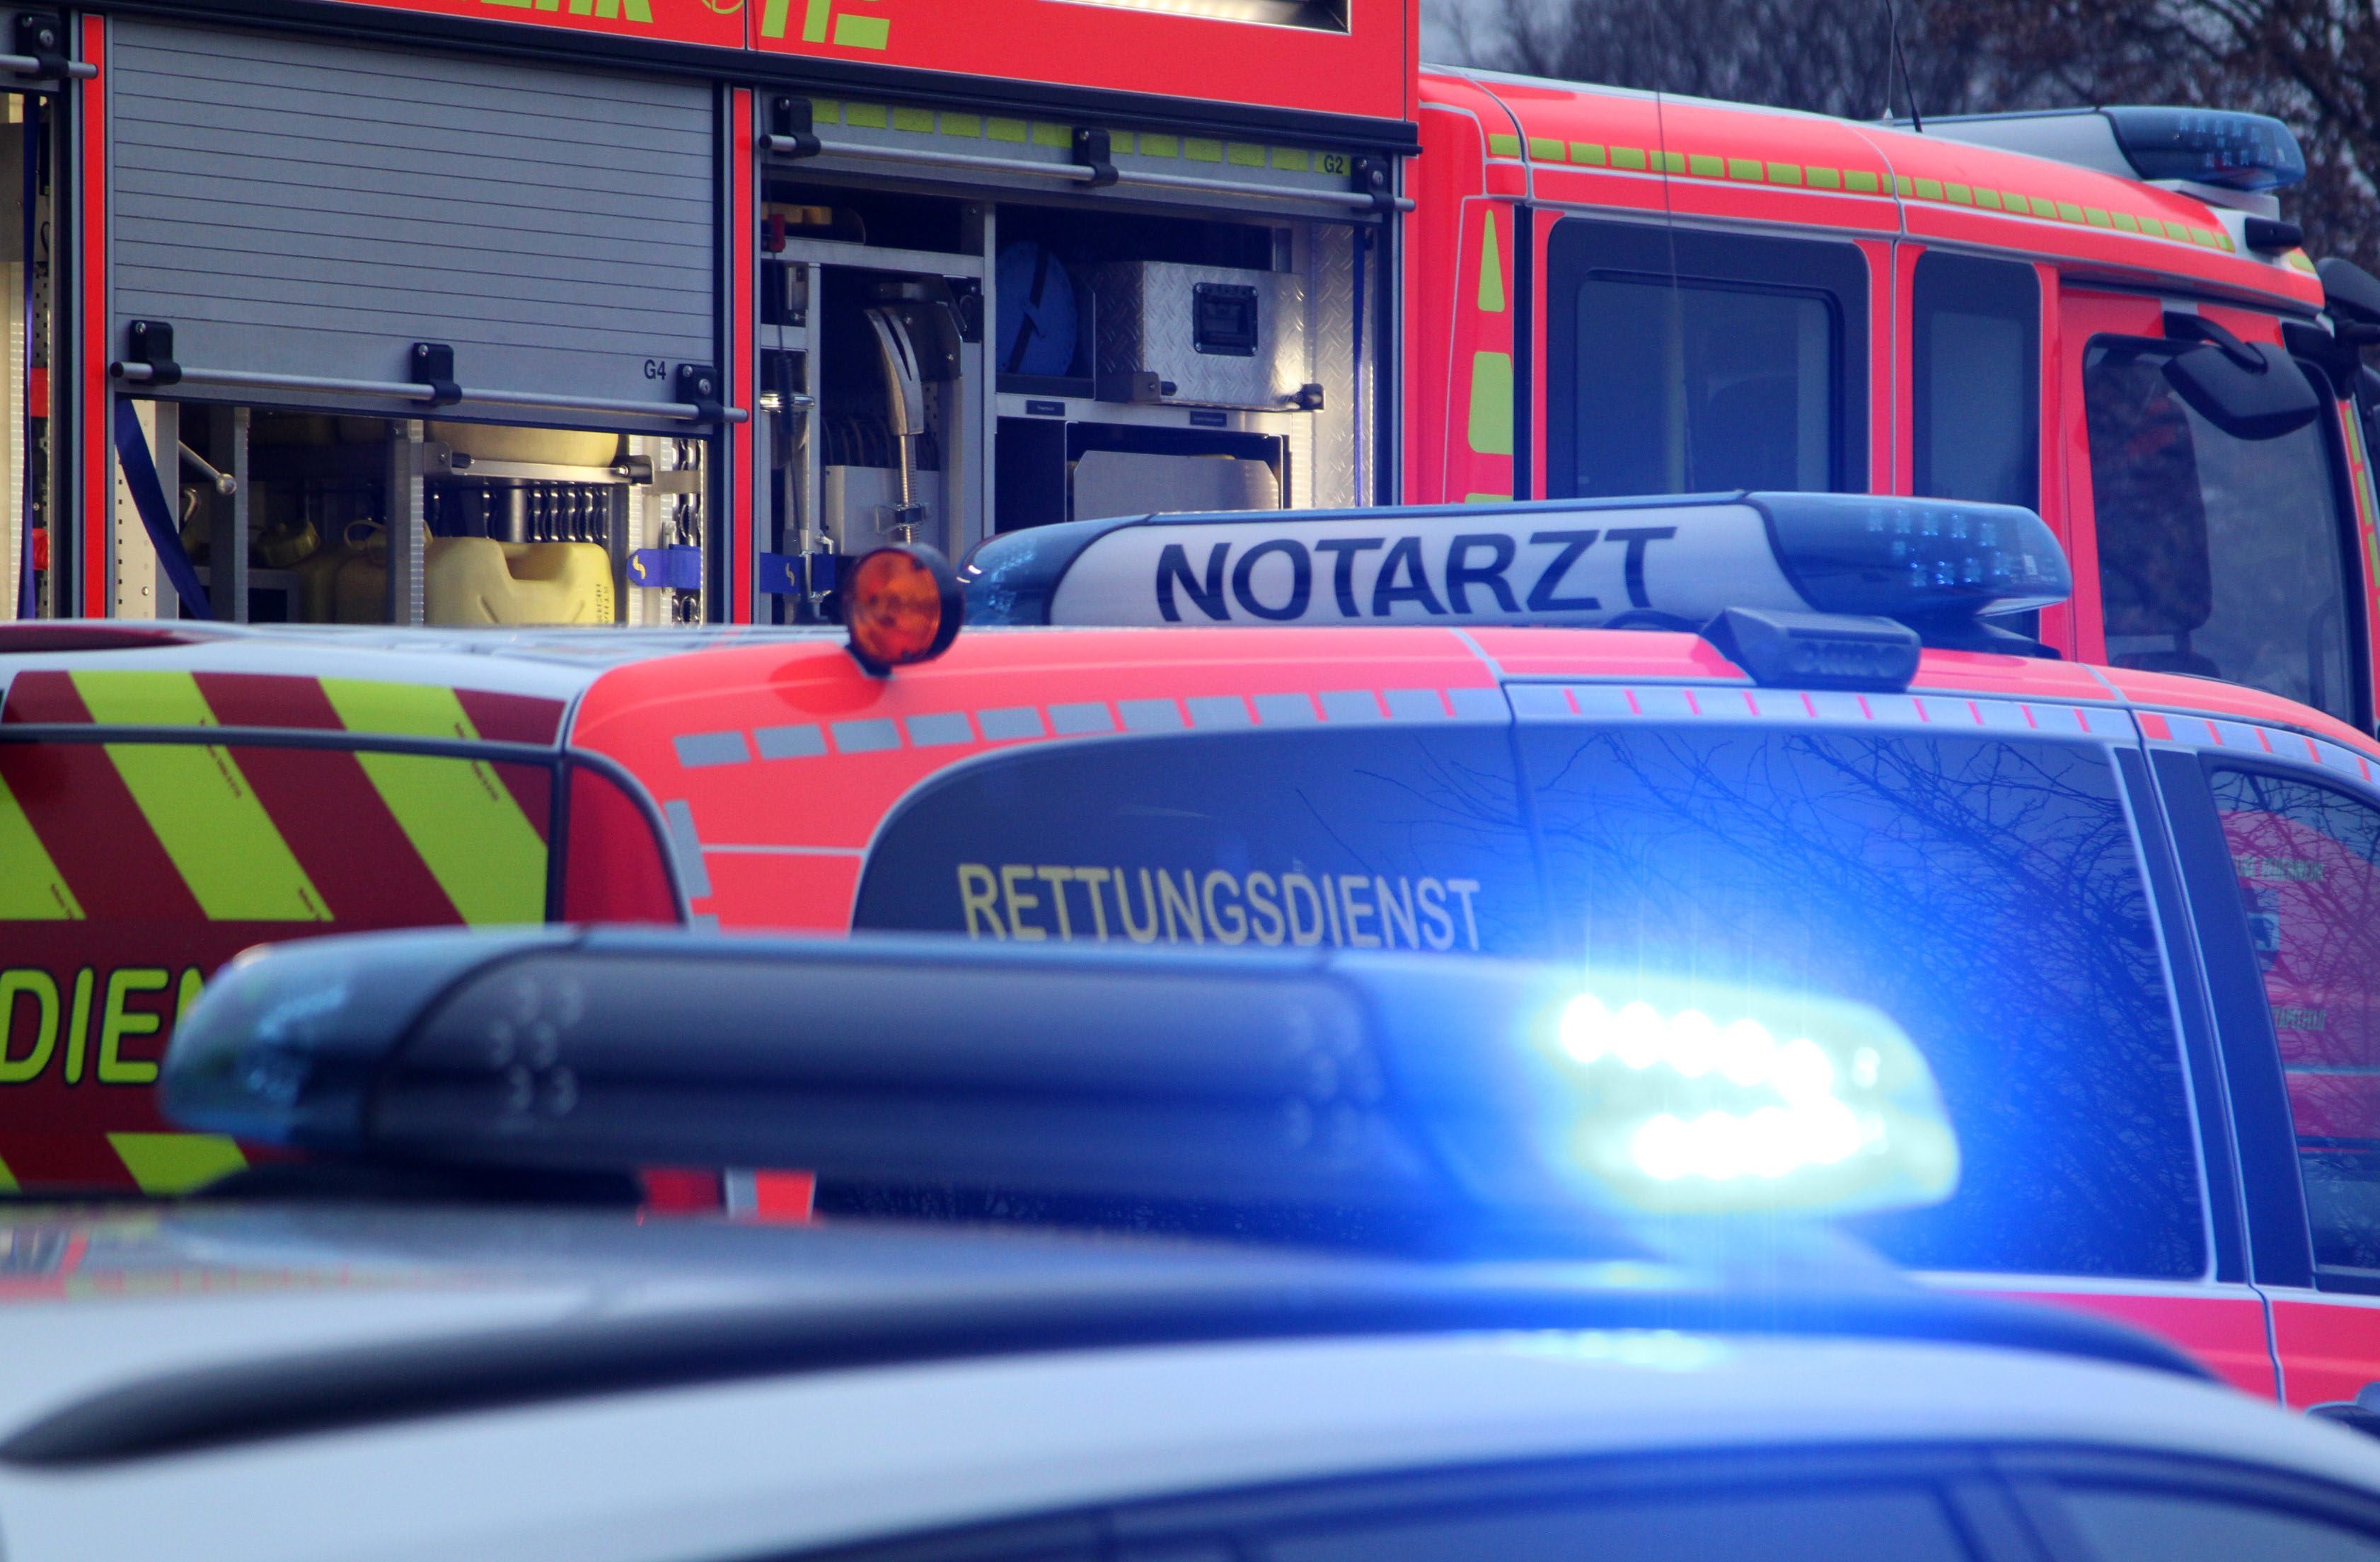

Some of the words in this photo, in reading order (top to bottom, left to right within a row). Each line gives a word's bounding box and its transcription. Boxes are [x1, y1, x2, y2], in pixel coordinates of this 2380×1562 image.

[1324, 154, 1344, 174] G2
[644, 359, 666, 381] G4
[1155, 526, 1677, 623] NOTARZT
[957, 863, 1481, 951] RETTUNGSDIENST
